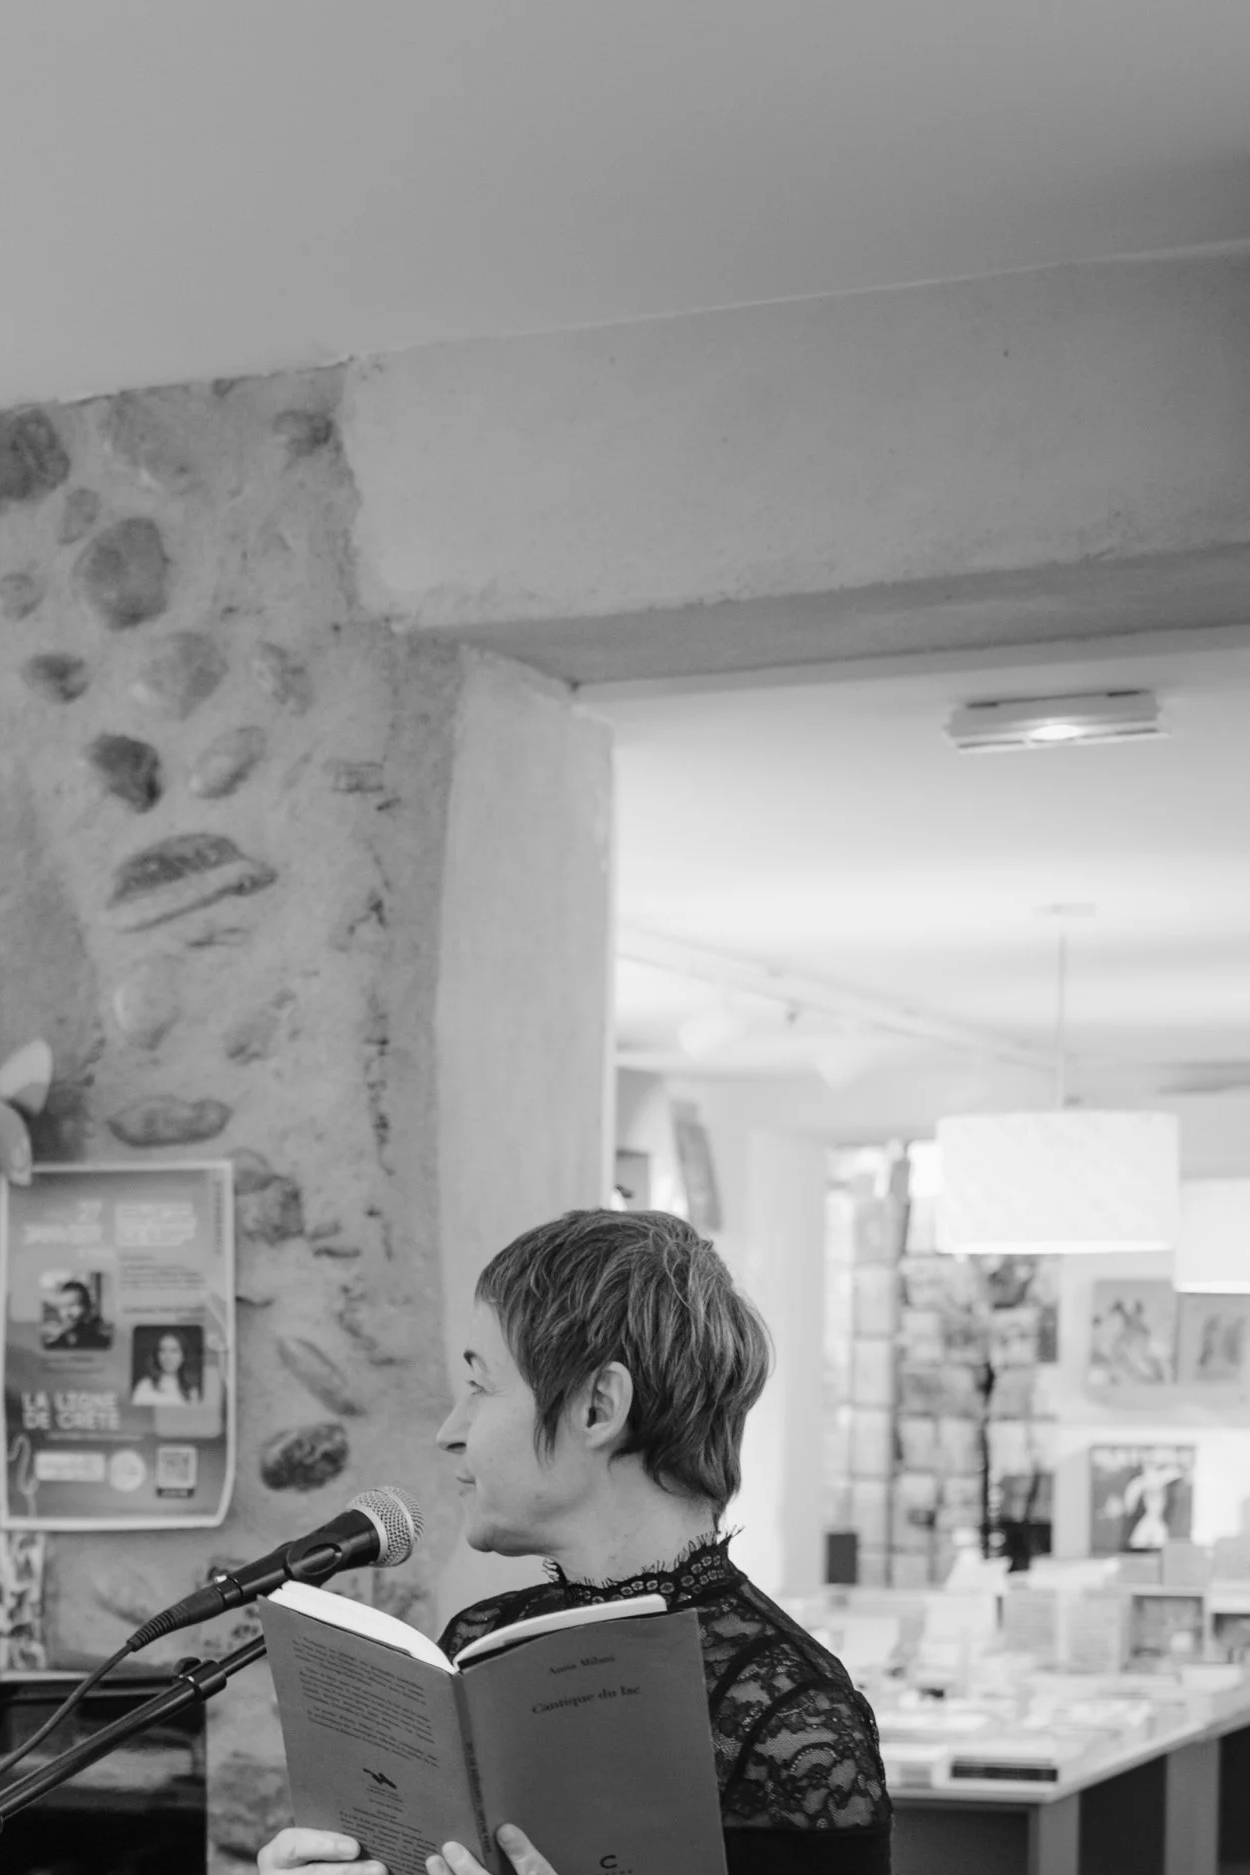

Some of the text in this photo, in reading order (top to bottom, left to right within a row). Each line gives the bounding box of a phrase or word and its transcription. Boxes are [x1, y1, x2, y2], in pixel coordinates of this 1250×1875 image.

[22, 1391, 49, 1411] LA
[23, 1411, 51, 1431] DE
[532, 1684, 641, 1714] Cantique du lac
